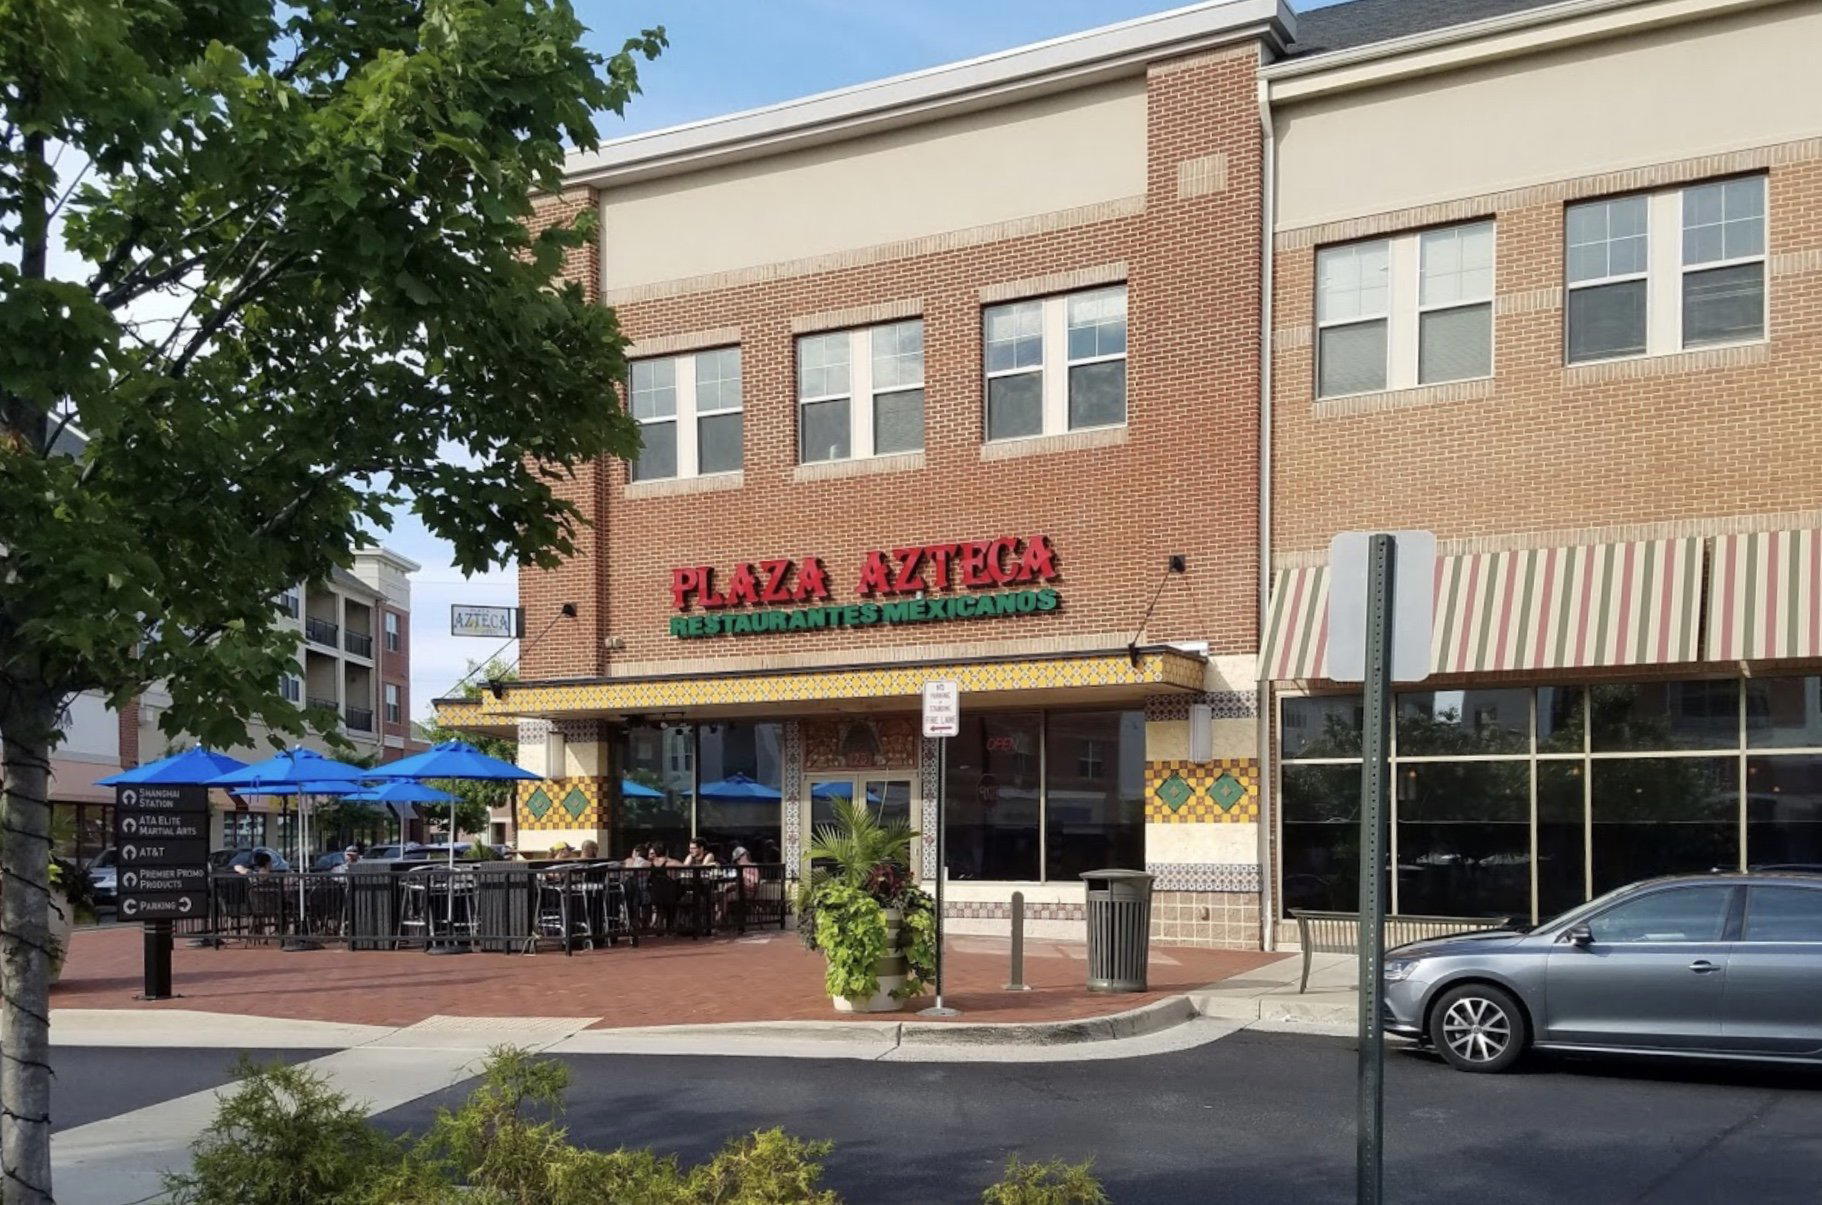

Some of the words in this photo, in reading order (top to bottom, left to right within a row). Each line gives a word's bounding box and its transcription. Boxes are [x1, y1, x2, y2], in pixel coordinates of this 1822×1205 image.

[672, 557, 828, 609] PLAZA
[855, 534, 1056, 594] AZTECA
[670, 603, 879, 636] RESTAURANTES
[882, 588, 1058, 622] MEXICANOS
[454, 612, 509, 631] AZTECA
[986, 737, 1018, 751] OPEN
[139, 789, 180, 798] SHANGHAI
[139, 800, 174, 808] STATION
[139, 816, 156, 826] ATA
[158, 816, 181, 826] ELITE
[139, 827, 174, 836] MARTIAL
[176, 827, 197, 836] ARTS
[139, 847, 165, 857] AT&T
[140, 869, 174, 879] PREMIER
[176, 869, 204, 878] PROMO
[140, 880, 182, 889] PRODUCTS
[140, 901, 176, 911] PARKING
